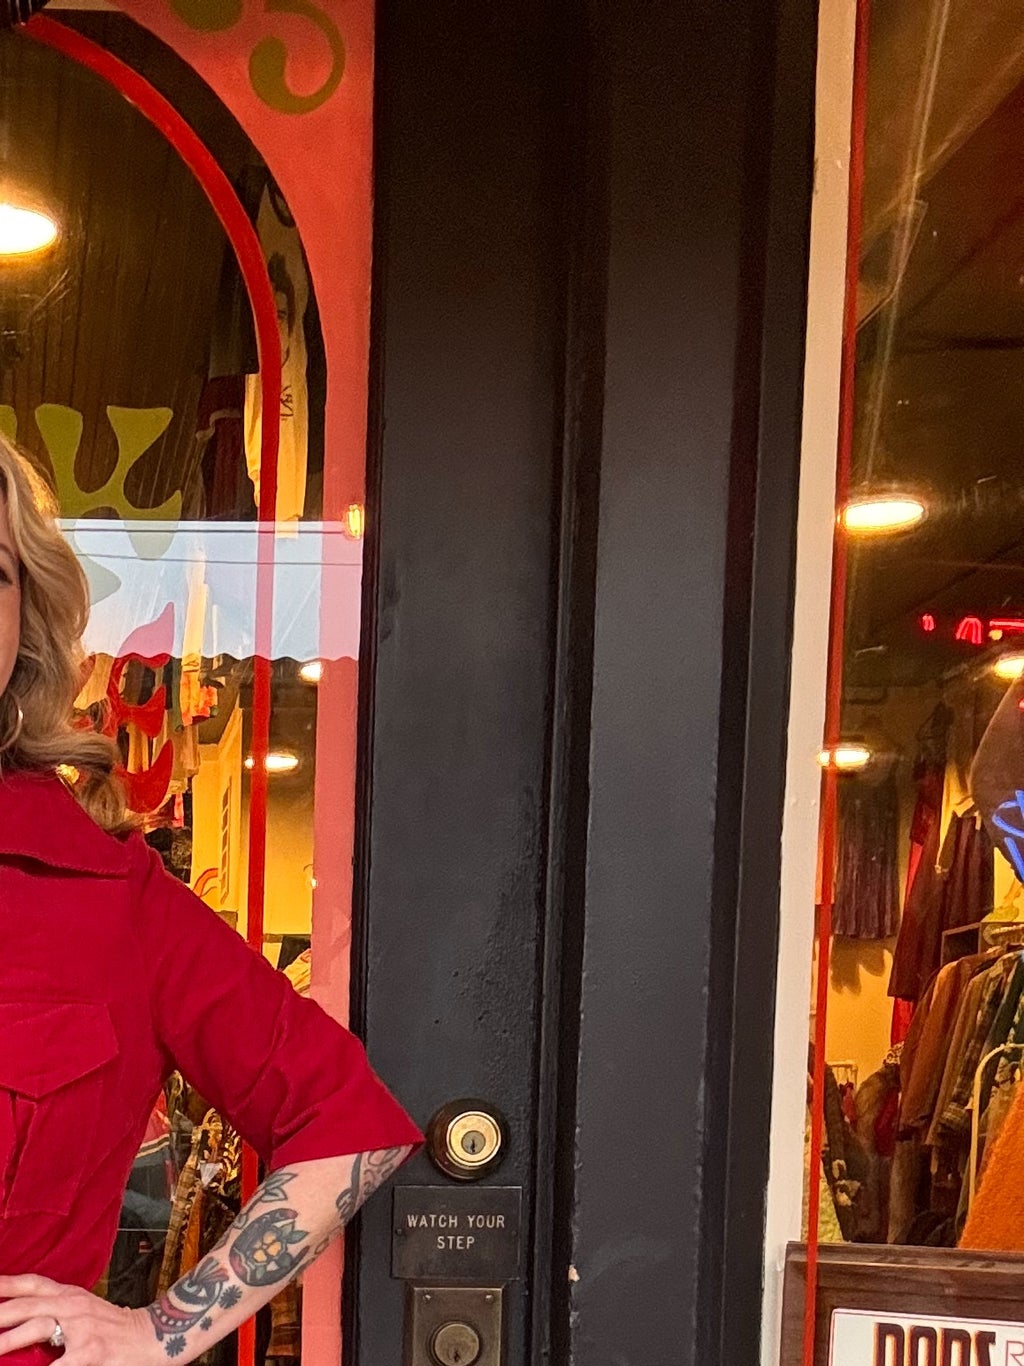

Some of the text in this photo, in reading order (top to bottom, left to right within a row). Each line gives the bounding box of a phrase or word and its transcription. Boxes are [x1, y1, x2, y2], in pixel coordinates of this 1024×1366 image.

[407, 1214, 505, 1228] WATCH YOUR
[436, 1235, 475, 1250] STEP
